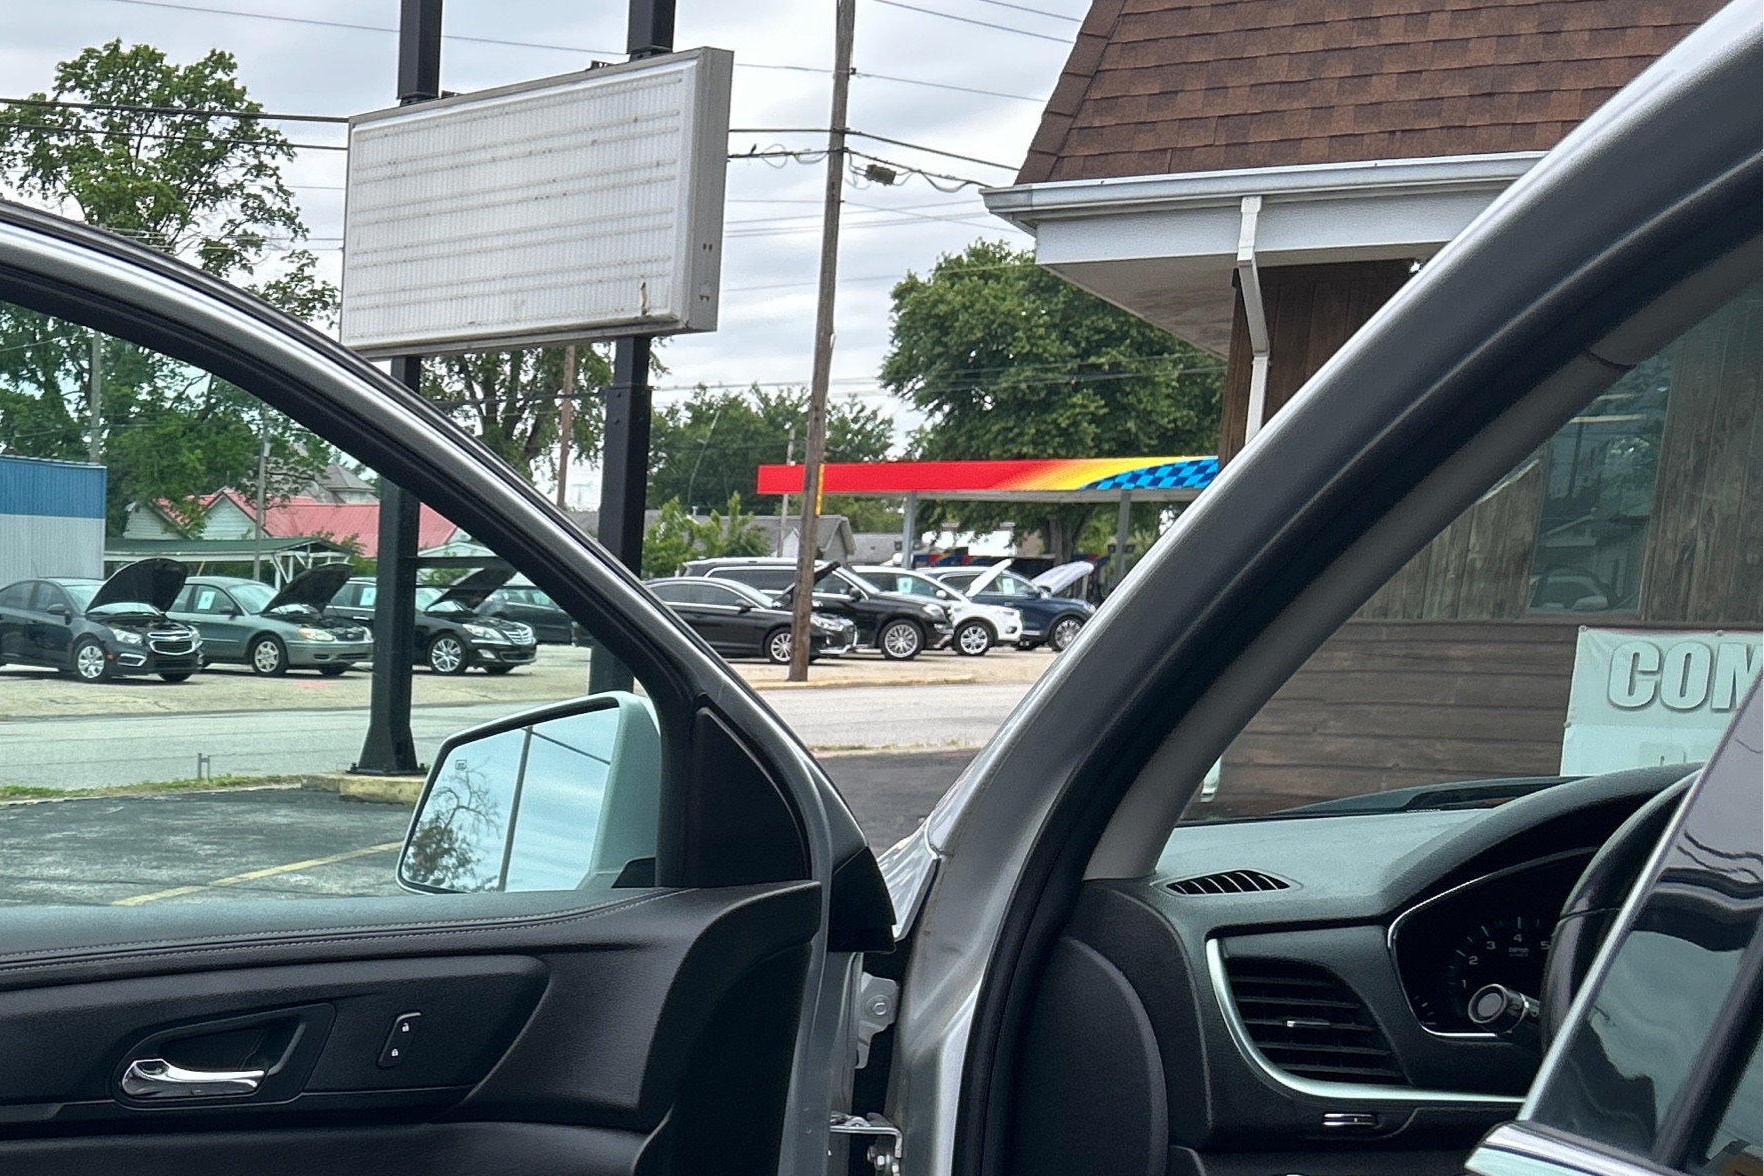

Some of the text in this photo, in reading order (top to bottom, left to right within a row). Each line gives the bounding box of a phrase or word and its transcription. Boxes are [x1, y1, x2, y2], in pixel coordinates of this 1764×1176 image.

[1513, 933, 1523, 943] 4
[1486, 941, 1496, 950] 3
[1540, 940, 1550, 950] 5
[1468, 955, 1479, 965] 2
